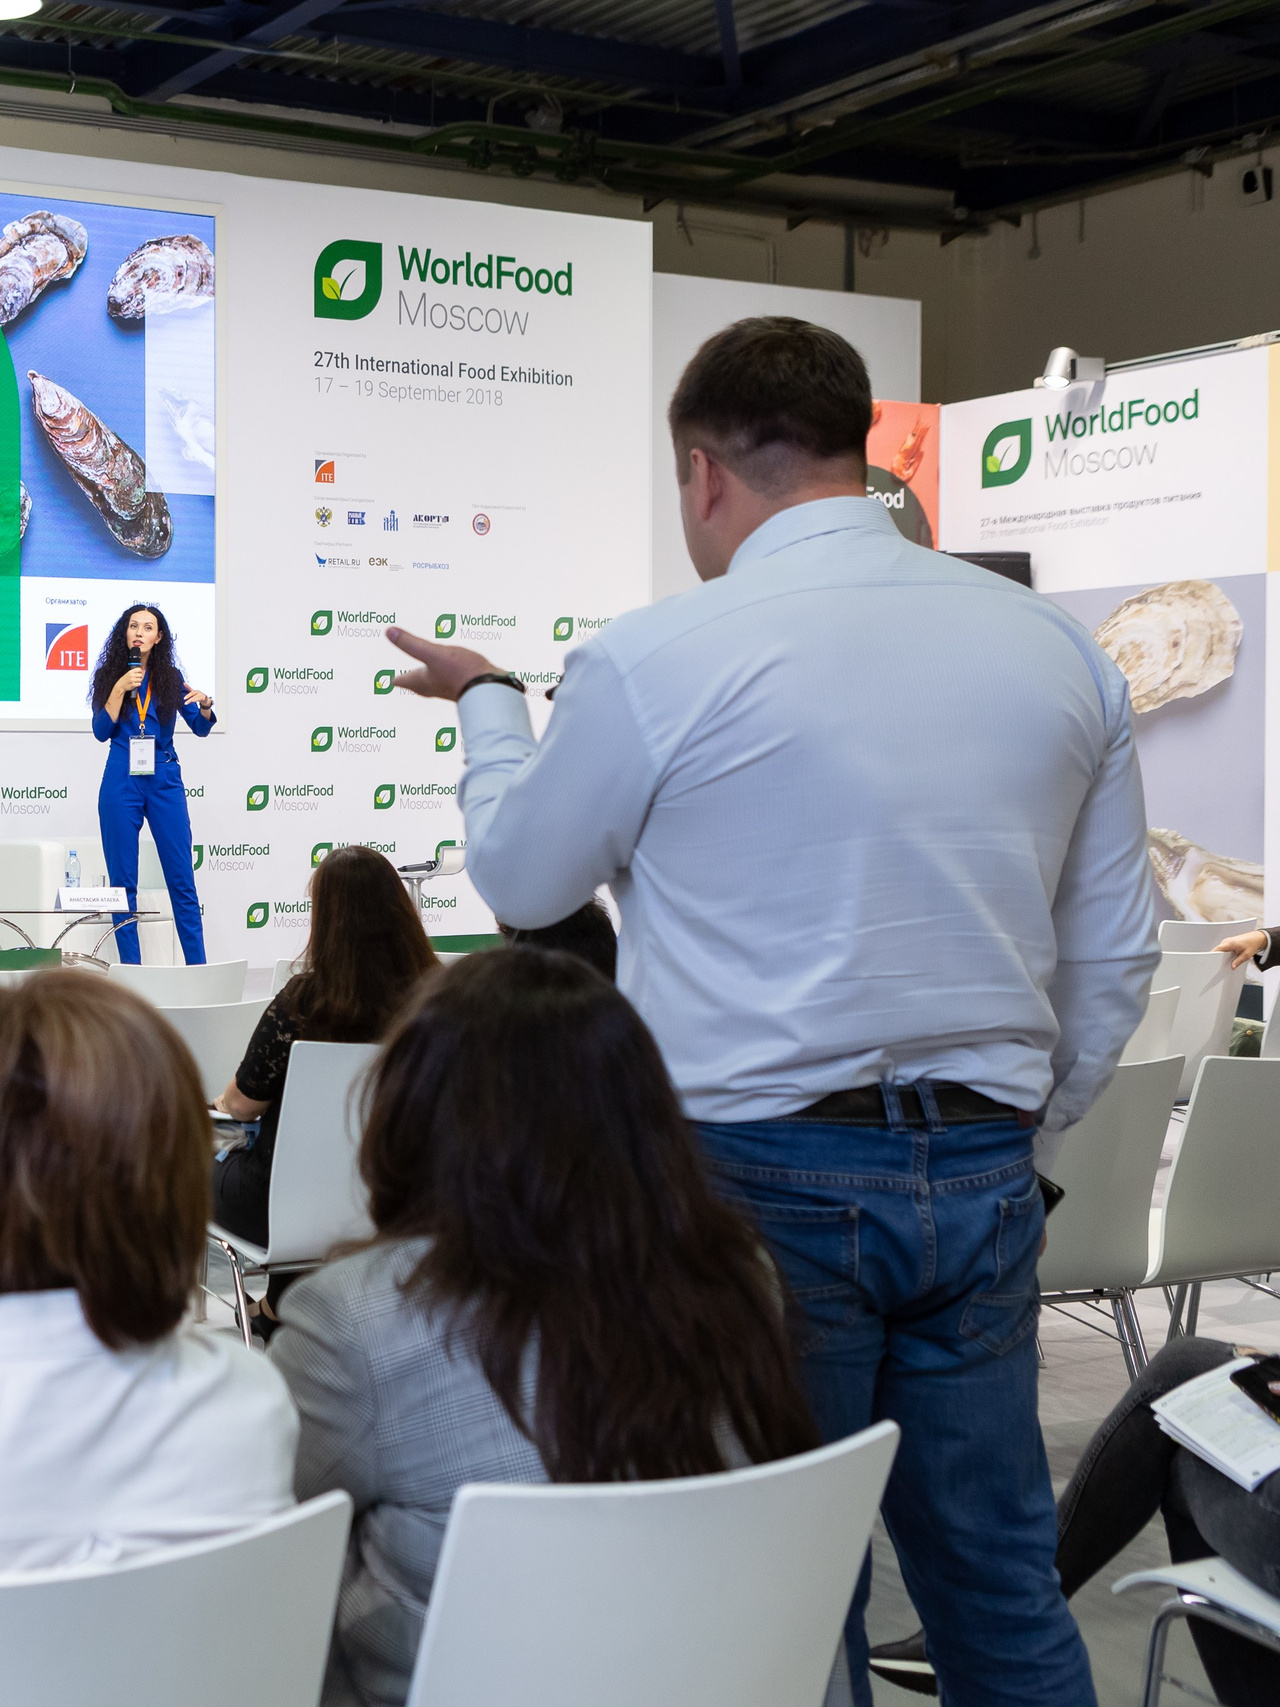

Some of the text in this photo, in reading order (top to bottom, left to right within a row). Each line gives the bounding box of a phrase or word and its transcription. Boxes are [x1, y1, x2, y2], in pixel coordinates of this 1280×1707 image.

[398, 245, 572, 296] WorldFood
[399, 290, 529, 335] Moscow
[314, 351, 573, 387] 27th International Food Exhibition
[315, 377, 333, 393] 17
[355, 379, 374, 397] 19
[378, 381, 461, 403] September
[466, 388, 503, 406] 2018
[1045, 388, 1200, 443] WorldFood
[1044, 442, 1158, 481] Moscow
[321, 473, 334, 482] ITE
[328, 558, 361, 567] RETAIL.RU
[413, 562, 450, 571] РОСРЫБХОЗ
[45, 597, 87, 606] Организатор
[337, 611, 396, 624] WorldFood
[460, 614, 516, 627] WorldFood
[337, 625, 381, 638] Moscow
[460, 628, 502, 641] Moscow
[60, 651, 86, 667] ITE
[273, 668, 334, 680] WorldFood
[273, 682, 318, 695] Moscow
[337, 727, 396, 739] WorldFood
[337, 741, 381, 753] Moscow
[1, 786, 67, 800] WorldFood
[274, 784, 334, 797] WorldFood
[400, 784, 457, 796] WorldFood
[1, 802, 50, 815] Moscow
[274, 799, 318, 811] Moscow
[399, 798, 442, 810] Moscow
[209, 843, 270, 857] WorldFood
[208, 859, 254, 871] Moscow
[274, 901, 312, 913] WorldF
